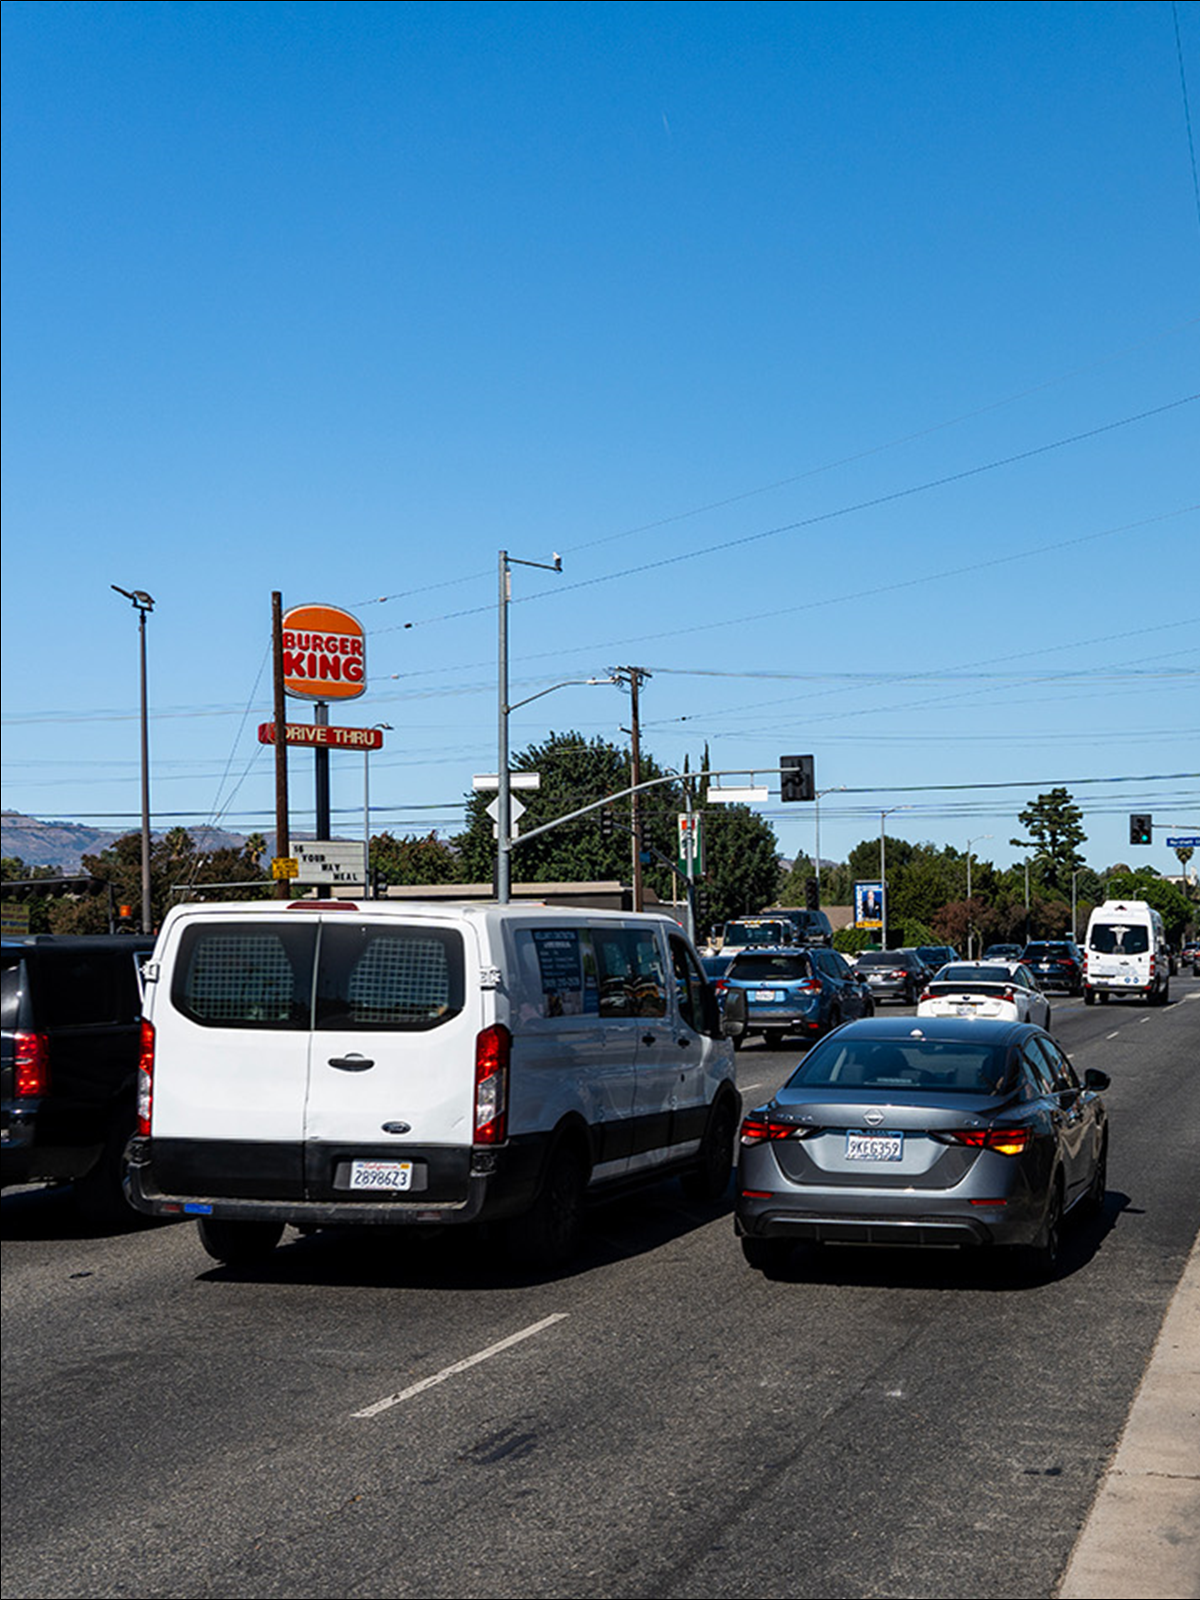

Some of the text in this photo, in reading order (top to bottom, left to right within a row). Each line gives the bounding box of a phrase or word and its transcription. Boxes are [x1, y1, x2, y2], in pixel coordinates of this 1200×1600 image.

[282, 631, 363, 656] BURGER
[282, 651, 364, 682] KING
[333, 729, 375, 746] THRU
[321, 864, 340, 872] WAY
[333, 873, 358, 881] MEAL
